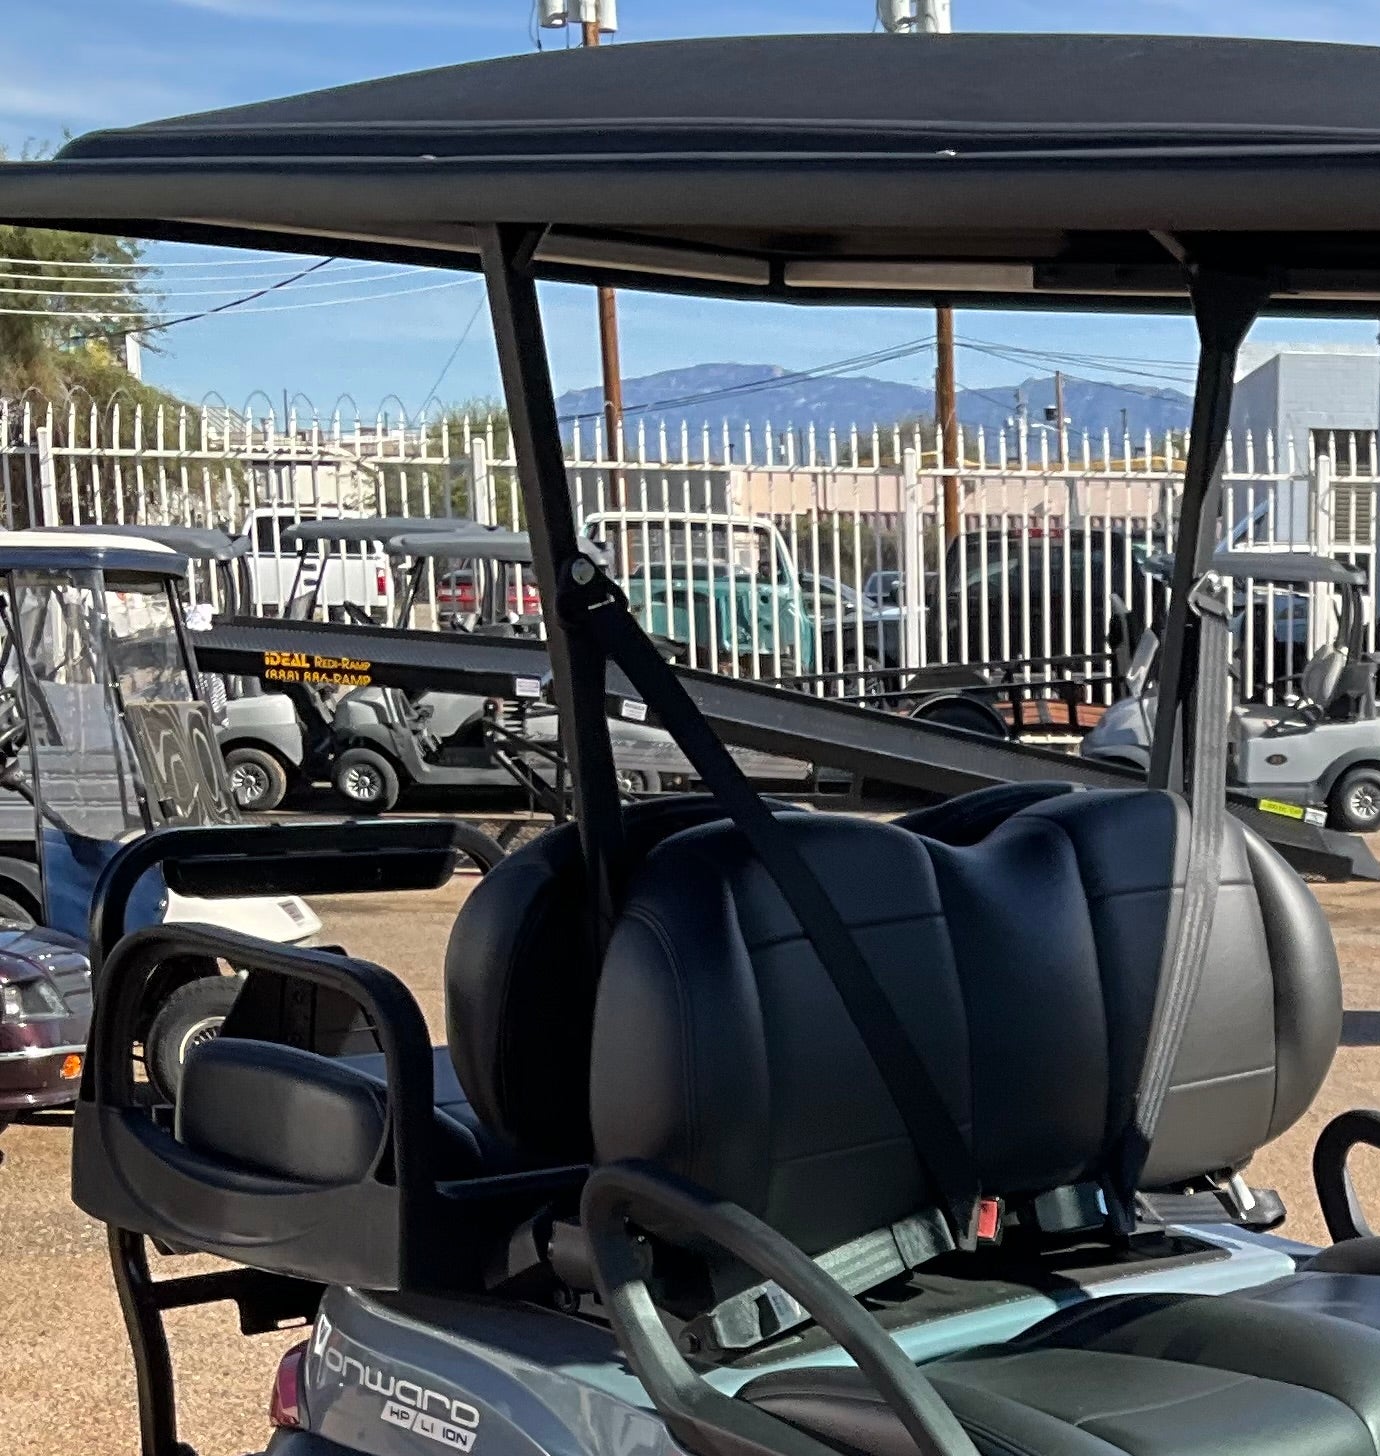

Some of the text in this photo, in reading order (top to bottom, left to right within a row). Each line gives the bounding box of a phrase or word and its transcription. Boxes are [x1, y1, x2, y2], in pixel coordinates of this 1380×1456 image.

[264, 651, 310, 668] IDEAL
[389, 1406, 468, 1446] HP LI ION
